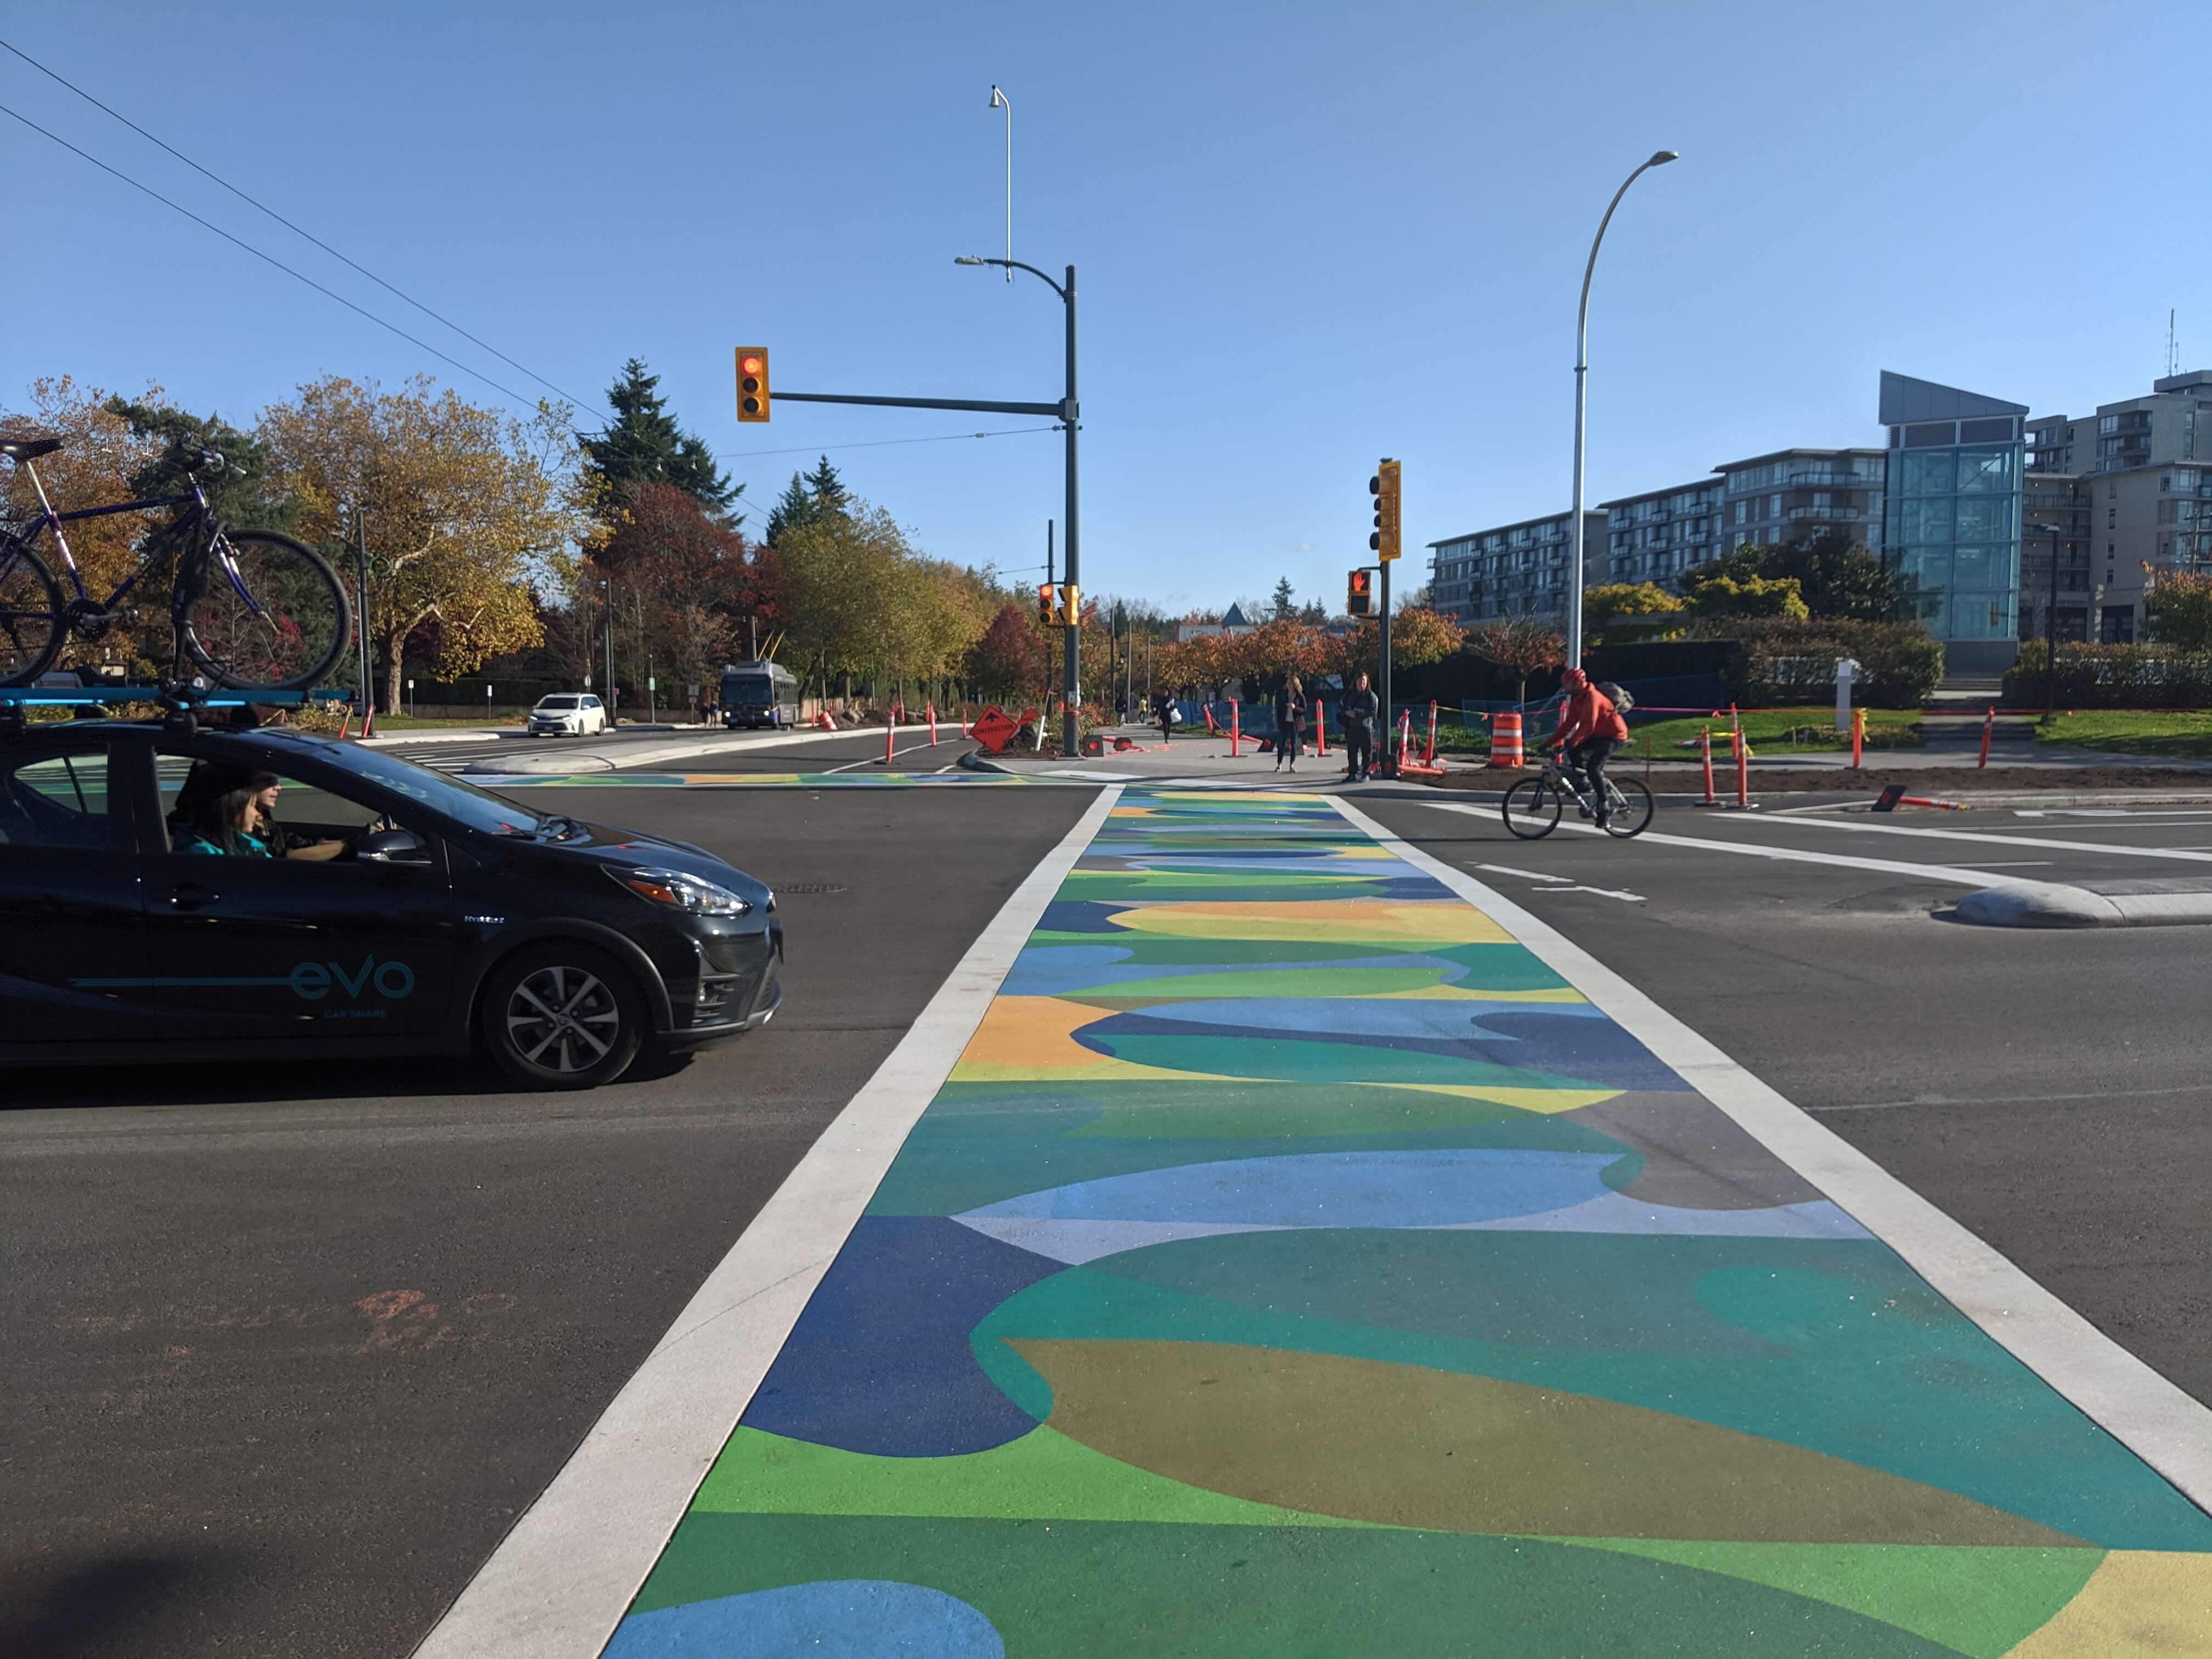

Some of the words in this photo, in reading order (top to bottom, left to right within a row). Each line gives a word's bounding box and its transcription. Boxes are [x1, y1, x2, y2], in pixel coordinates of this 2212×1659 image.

[973, 724, 1013, 735] CONSTRUCTION
[290, 953, 414, 999] evo
[324, 1009, 347, 1019] CAR
[351, 1009, 387, 1019] SHARE
